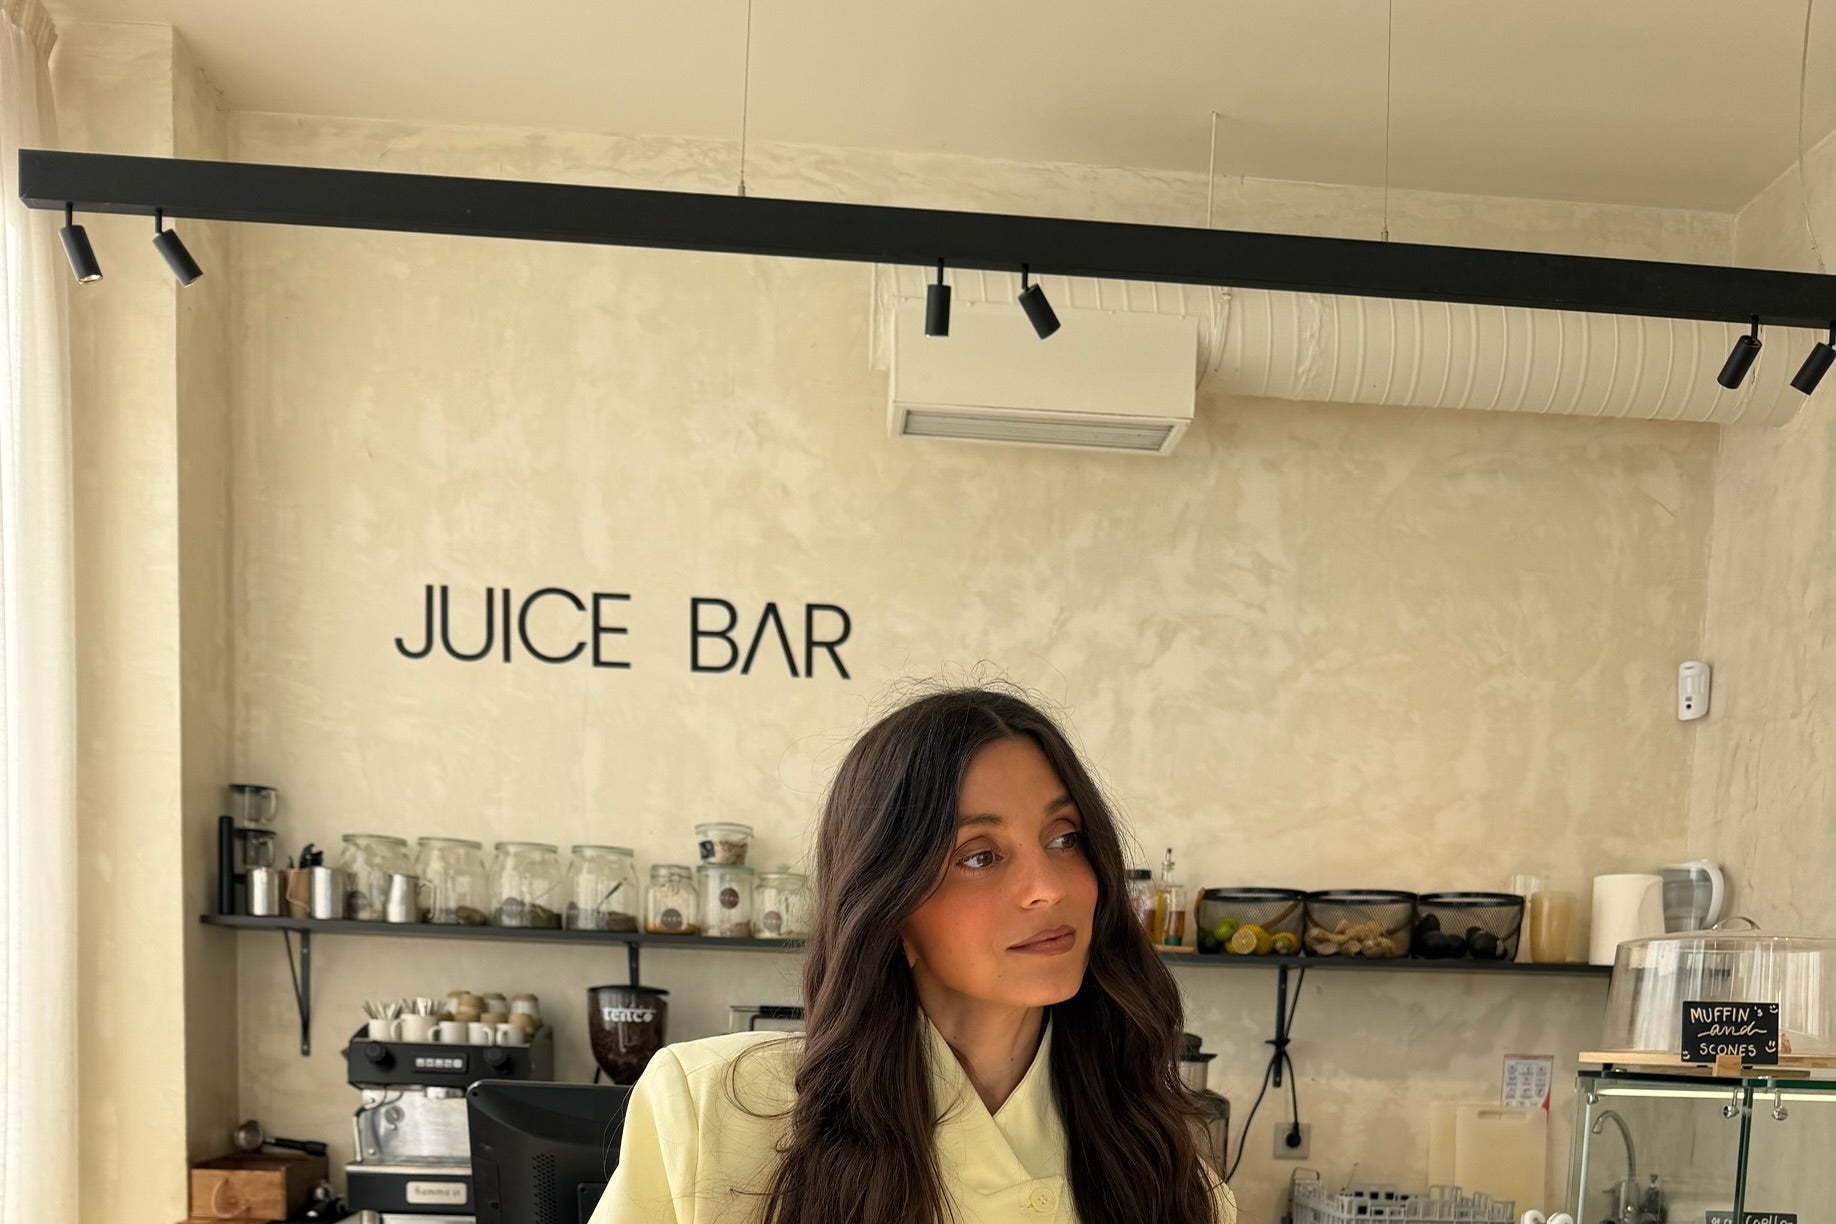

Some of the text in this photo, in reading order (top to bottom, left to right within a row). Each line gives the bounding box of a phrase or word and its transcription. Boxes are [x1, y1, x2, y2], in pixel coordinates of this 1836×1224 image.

[394, 584, 852, 680] JUICE BAR
[1697, 1021, 1767, 1037] and
[1699, 1042, 1757, 1057] SCONES
